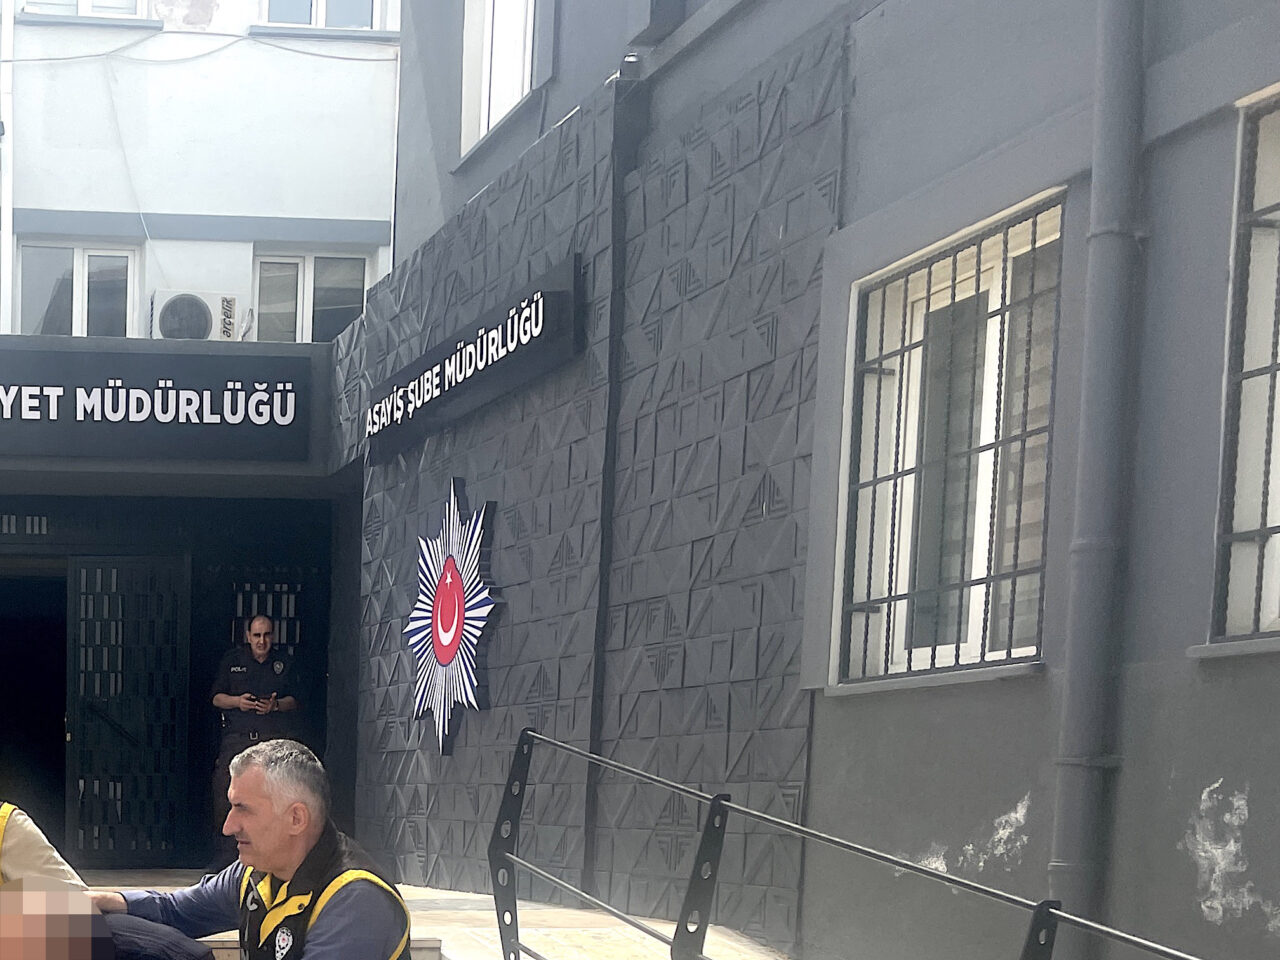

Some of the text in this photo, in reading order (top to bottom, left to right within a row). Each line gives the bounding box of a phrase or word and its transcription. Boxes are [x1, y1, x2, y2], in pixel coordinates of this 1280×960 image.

[76, 379, 295, 426] MÜDÜRLÜĞÜ
[365, 290, 544, 437] ASAYİŞ ŞUBE MÜDÜRLÜĞÜ
